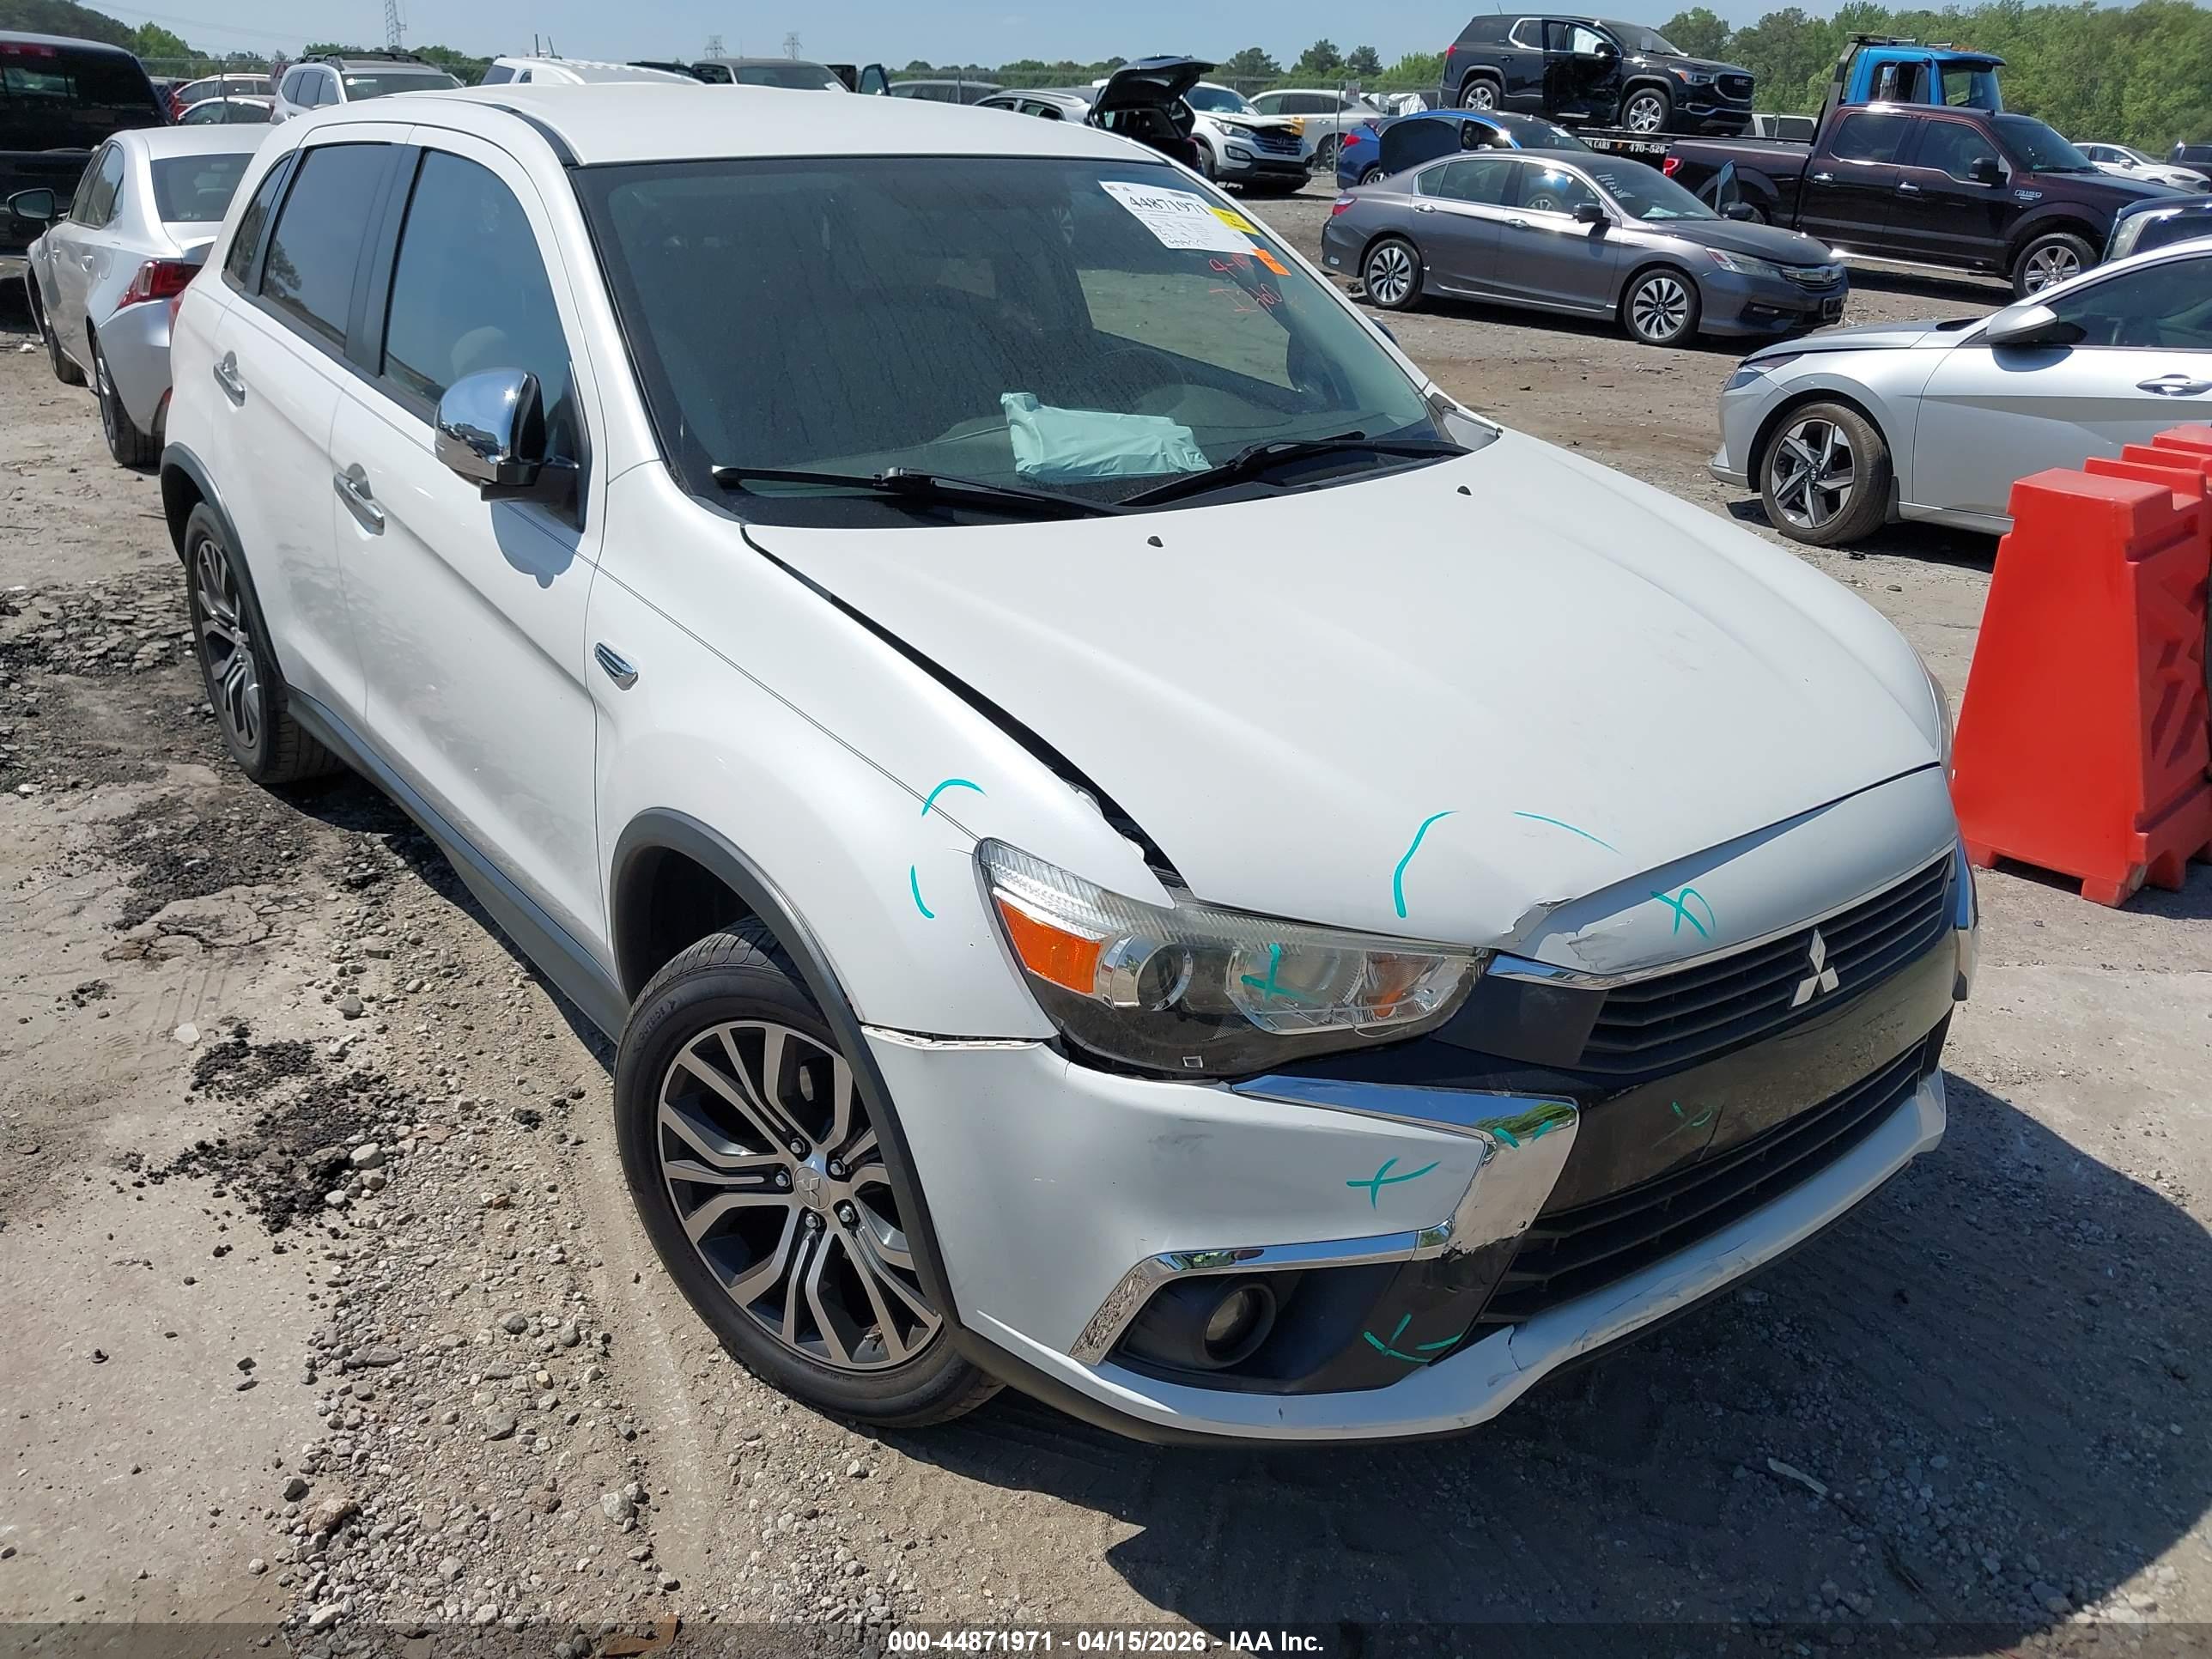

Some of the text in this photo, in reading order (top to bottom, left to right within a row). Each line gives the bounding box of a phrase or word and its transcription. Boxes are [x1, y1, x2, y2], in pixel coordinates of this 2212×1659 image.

[1594, 141, 1611, 150] CARS
[1129, 196, 1211, 216] 44871971
[638, 1006, 666, 1041] OUTSIDE
